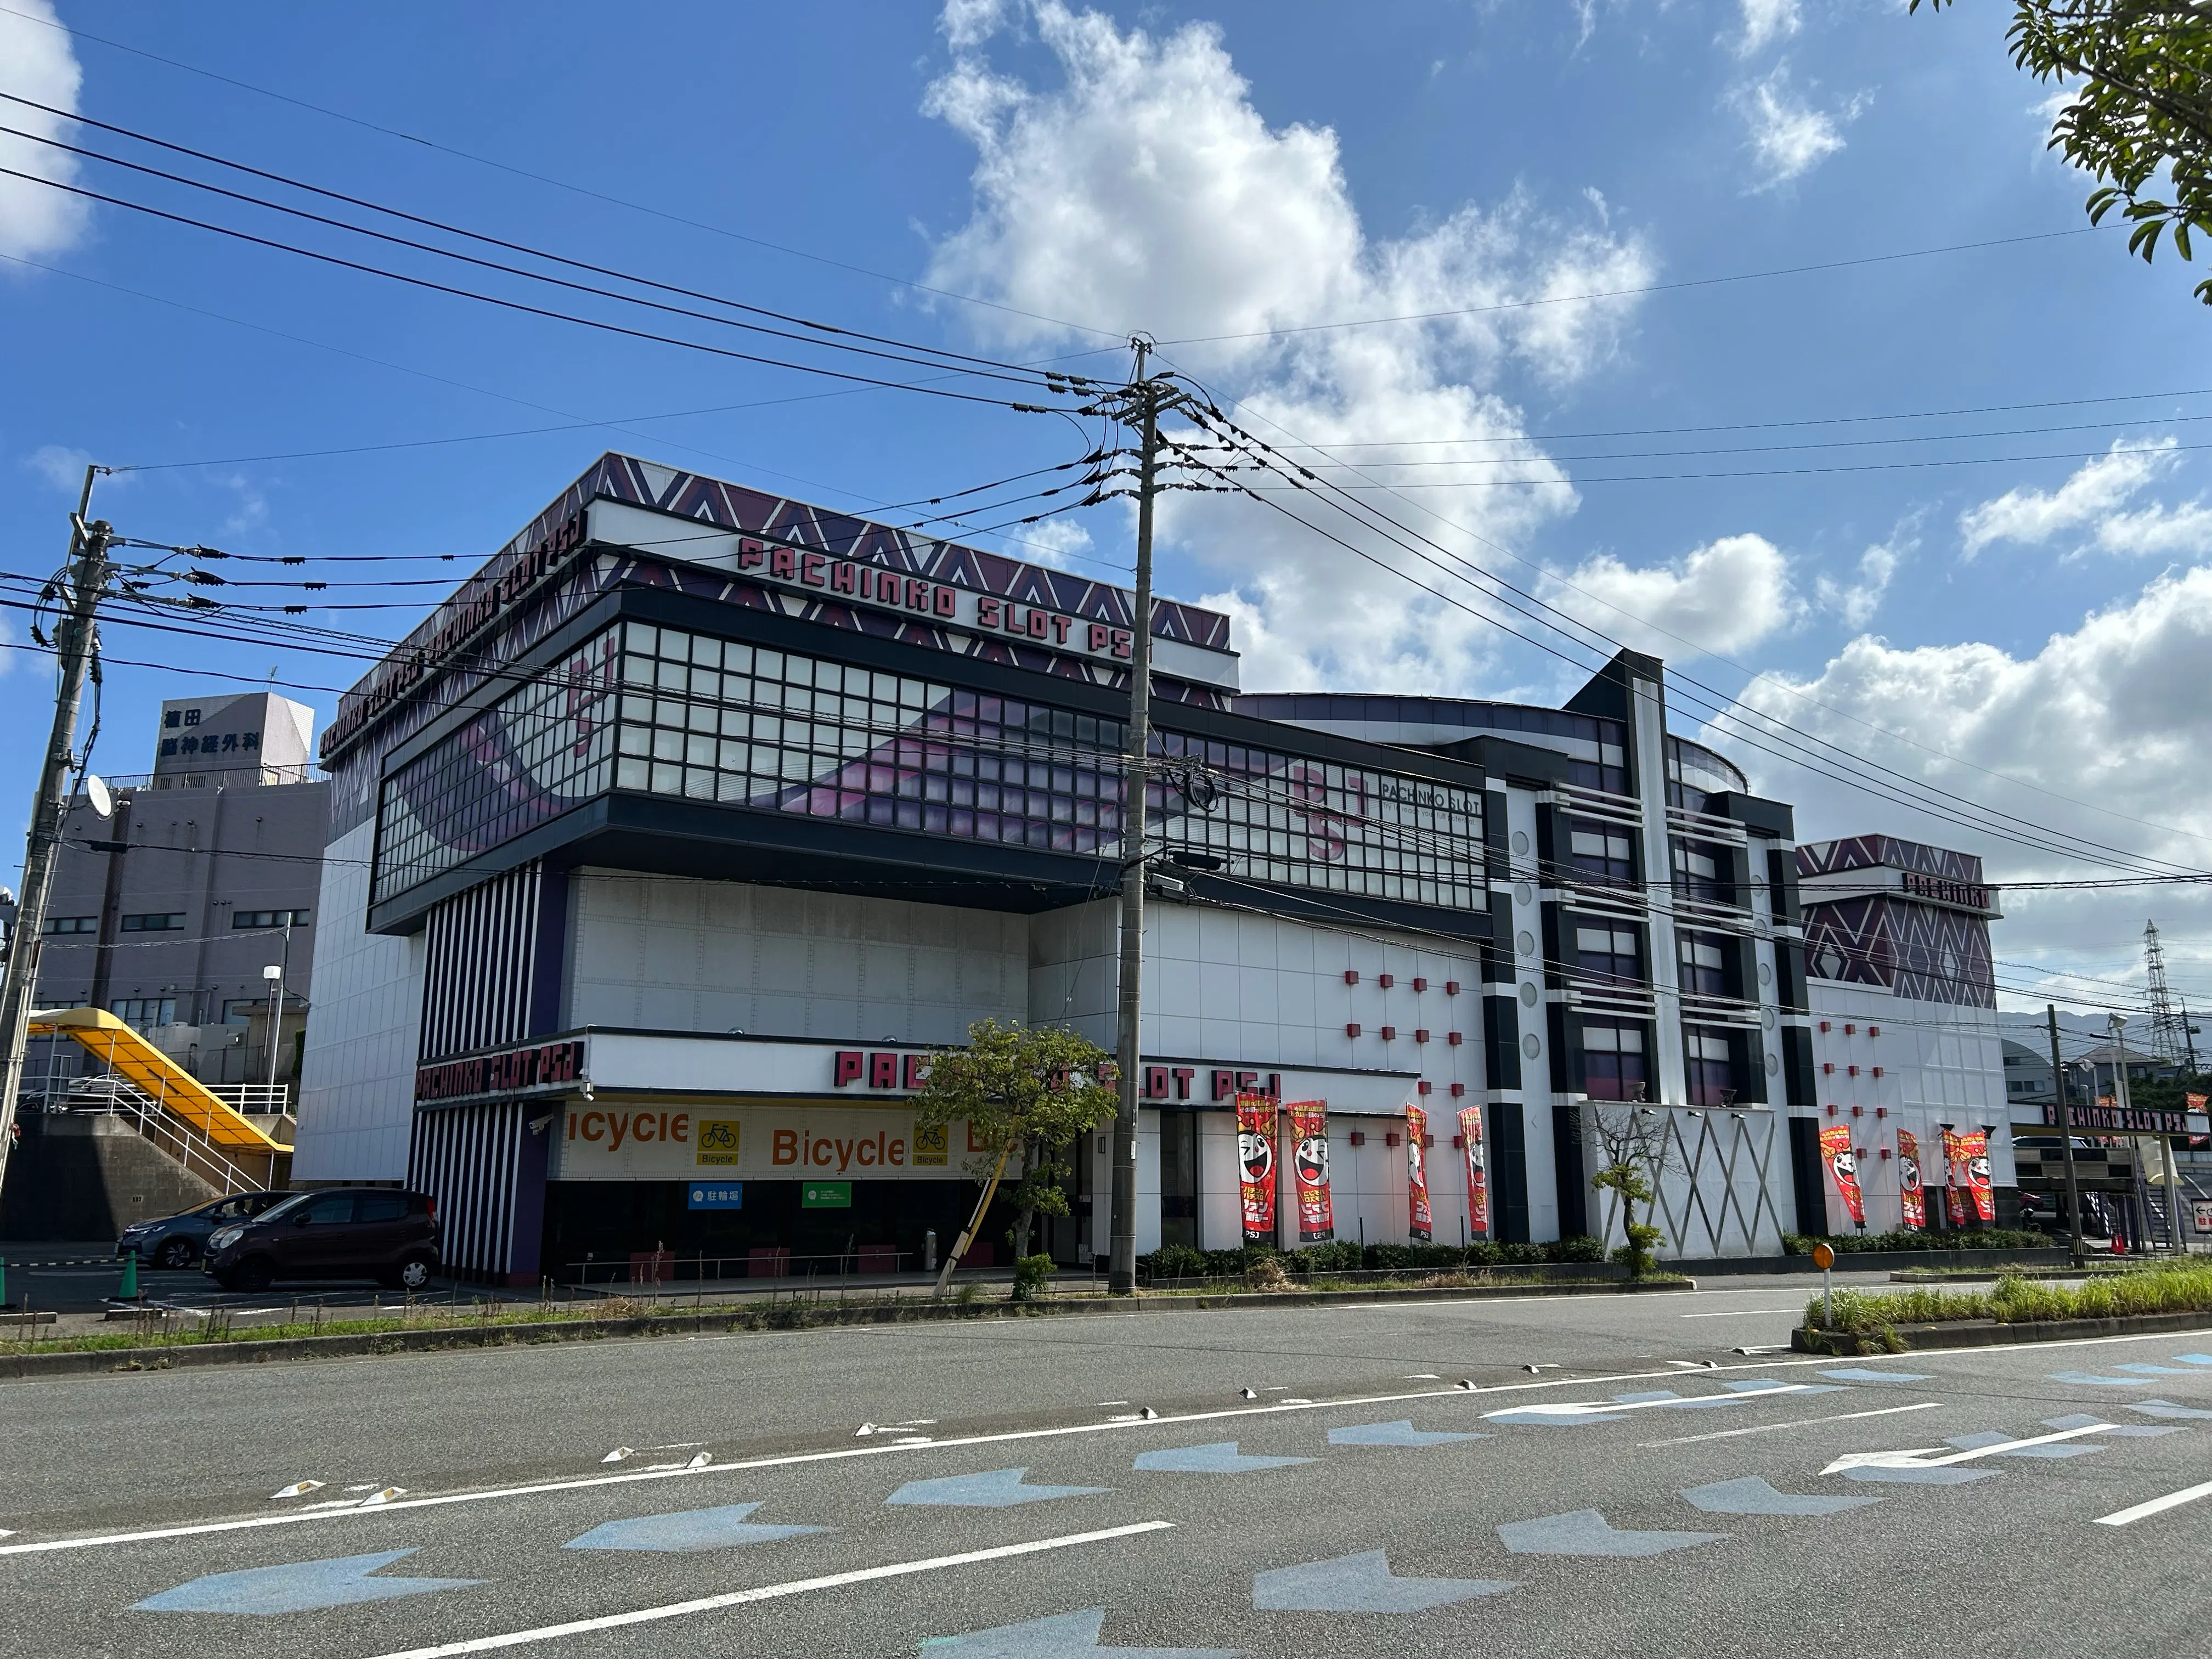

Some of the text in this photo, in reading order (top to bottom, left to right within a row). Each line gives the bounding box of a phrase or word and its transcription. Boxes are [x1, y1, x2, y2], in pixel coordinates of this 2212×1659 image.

[738, 538, 1152, 663] PACHINKO SLOT PS
[1382, 783, 1444, 808] PACHNKO
[415, 1041, 585, 1101] PACHINKO SLOT PSJ
[2046, 1105, 2119, 1128] PCHINKO
[702, 1155, 733, 1164] Bicycle
[772, 1130, 904, 1172] Bicycle
[917, 1156, 944, 1165] Bicycle
[707, 1190, 738, 1201] 駐輪場
[1420, 1231, 1429, 1239] PSJ
